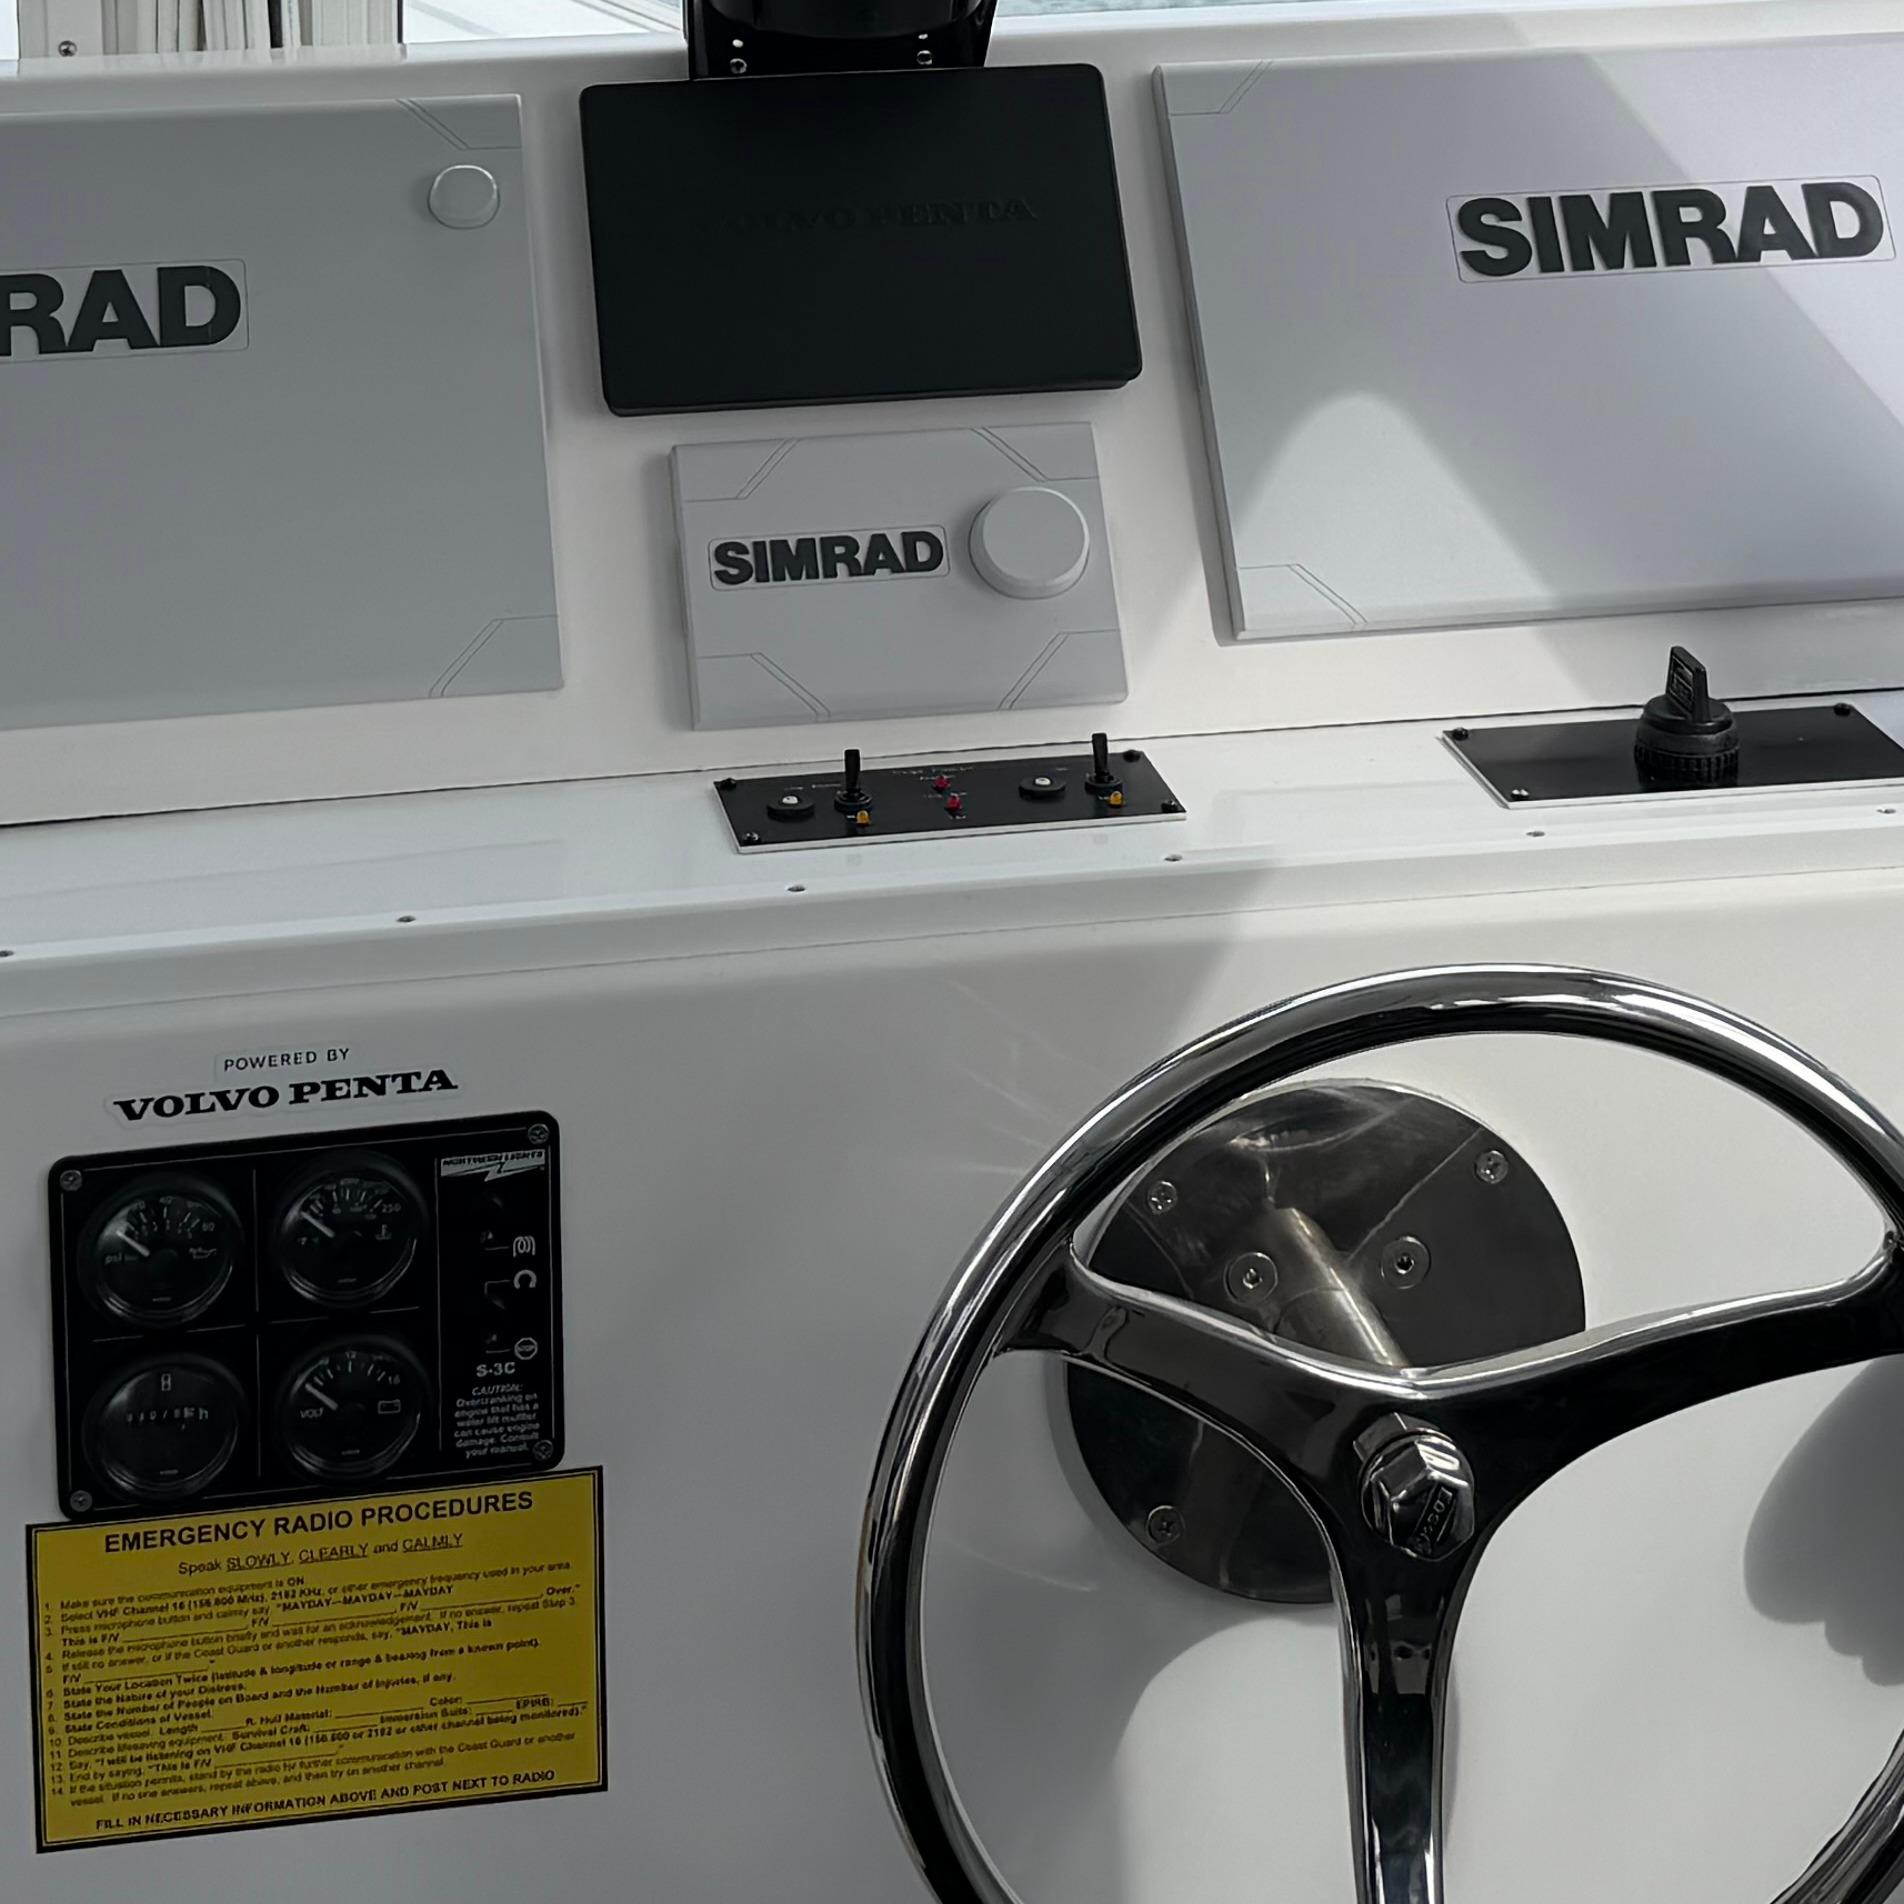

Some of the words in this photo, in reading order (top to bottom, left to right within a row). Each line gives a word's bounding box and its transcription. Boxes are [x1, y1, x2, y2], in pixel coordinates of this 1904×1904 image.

[1456, 181, 1885, 277] SIMRAD
[712, 530, 944, 586] SIMRAD
[223, 1051, 318, 1072] POWERED
[327, 1048, 350, 1064] BY
[114, 1085, 280, 1122] VOLVO
[289, 1068, 458, 1105] PENTA
[476, 1361, 516, 1377] S-3C
[104, 1519, 264, 1553] EMERGENCY
[273, 1510, 352, 1536] RADIO
[361, 1491, 533, 1527] PROCEDURES
[177, 1558, 221, 1575] Speak
[373, 1540, 398, 1553] and
[402, 1533, 463, 1552] CALMLY
[95, 1817, 122, 1830] FILL
[144, 1806, 228, 1825] NECESSARY
[231, 1795, 325, 1815] INFORMATION
[329, 1789, 376, 1804] ABOVE
[380, 1786, 409, 1799] AND
[412, 1782, 447, 1795] POST
[452, 1777, 487, 1791] NEXT
[490, 1775, 508, 1787] TO
[512, 1770, 555, 1784] RADIO
